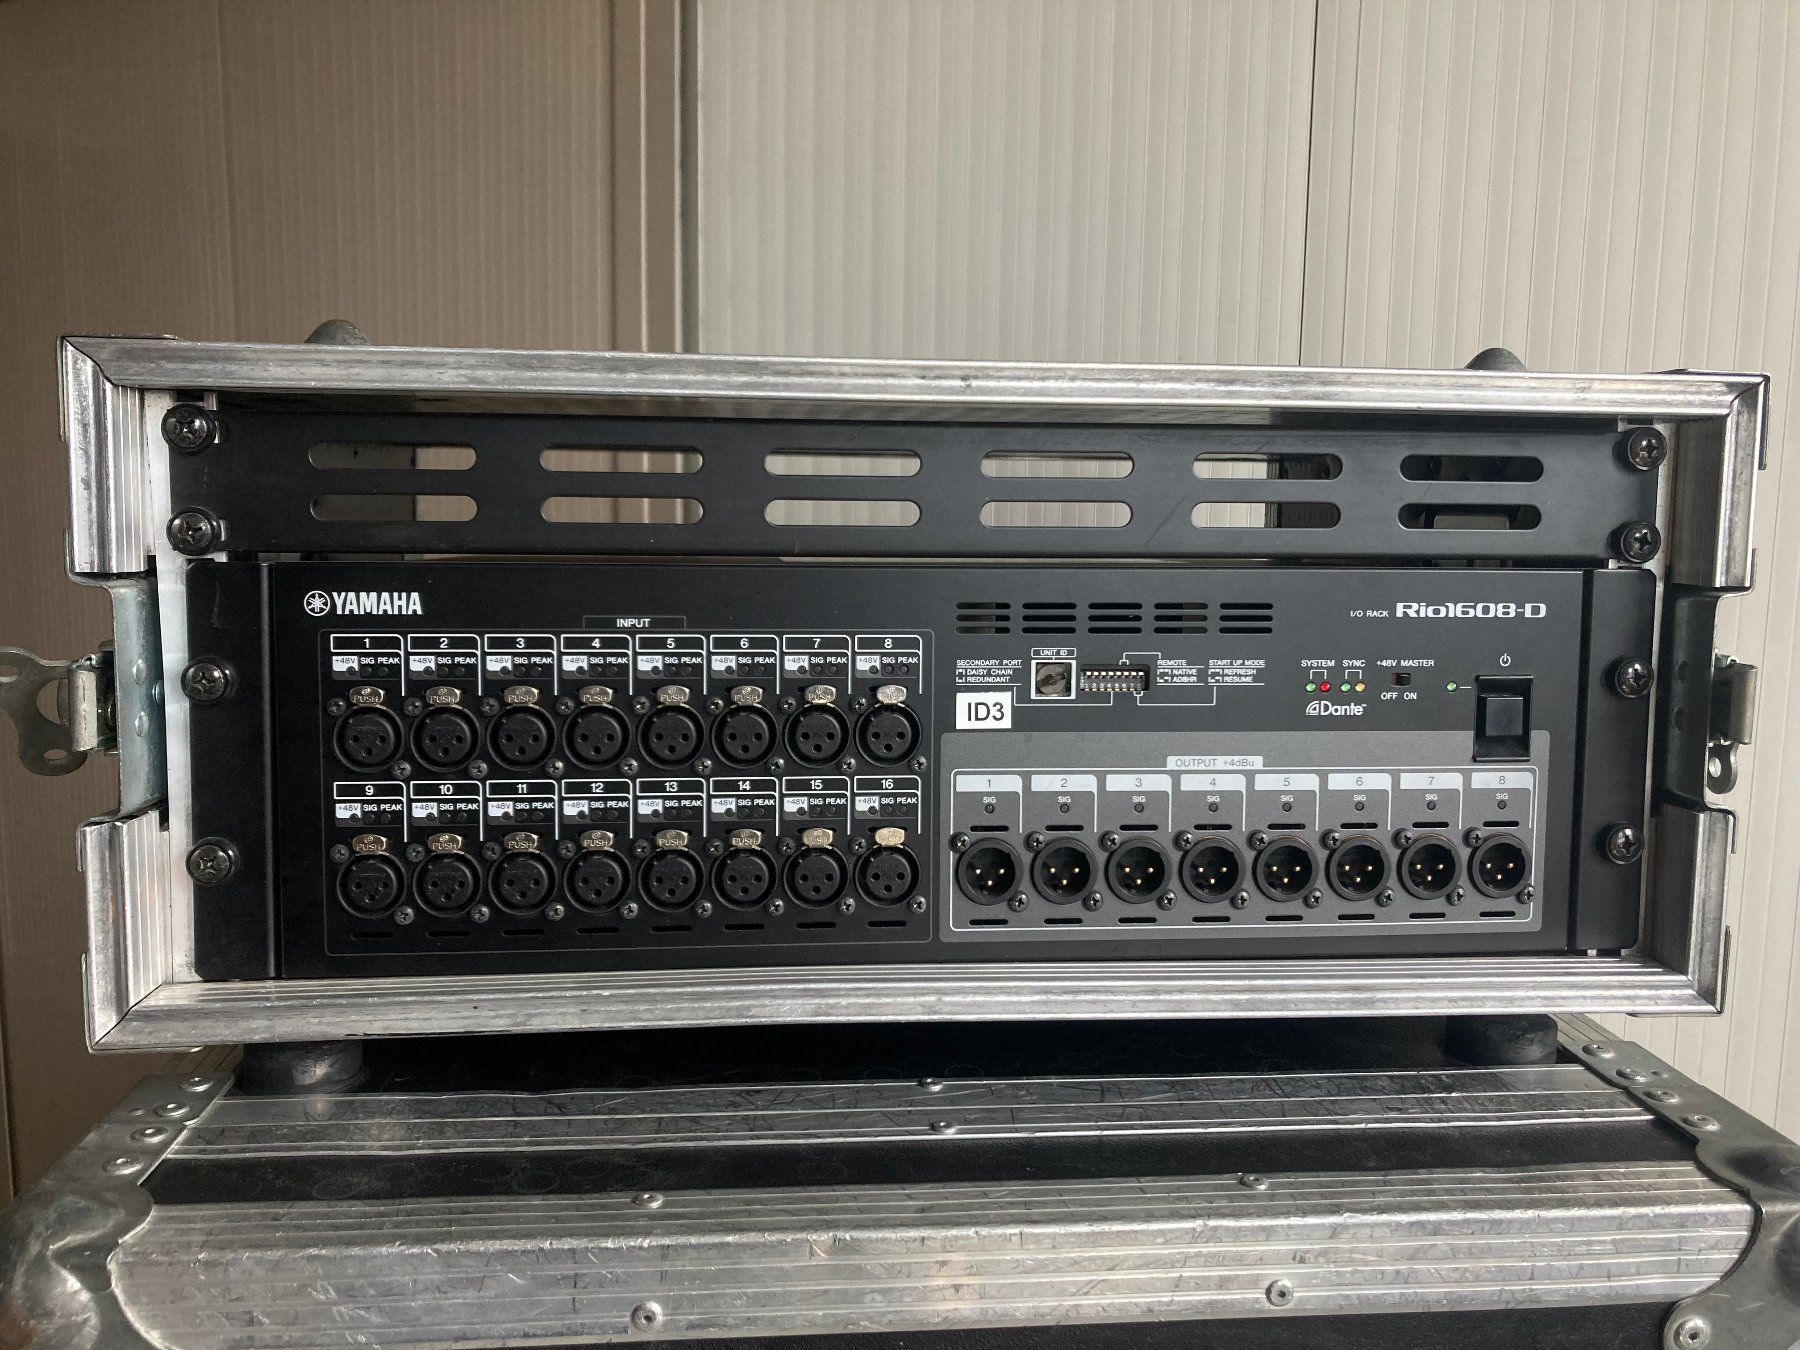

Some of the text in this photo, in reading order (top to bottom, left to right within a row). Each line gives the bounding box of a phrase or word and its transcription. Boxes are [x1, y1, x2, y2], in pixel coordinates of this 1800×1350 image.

[332, 592, 423, 615] YAMAHA
[1395, 602, 1546, 618] Rio1608-D
[617, 618, 651, 628] INPUT
[363, 638, 370, 648] 1
[440, 638, 448, 648] 2
[516, 638, 525, 648] 3
[591, 638, 600, 648] 4
[667, 638, 675, 648] 5
[740, 638, 748, 648] 6
[813, 638, 820, 648] 7
[884, 638, 892, 648] 8
[360, 656, 375, 664] SIG
[377, 656, 400, 664] PEAK
[437, 656, 452, 664] SIG
[454, 656, 477, 664] PEAK
[513, 656, 528, 664] SIG
[530, 656, 553, 664] PEAK
[589, 656, 604, 664] SIG
[606, 656, 629, 664] PEAK
[639, 656, 703, 665] +48V SIG PEAK
[713, 656, 776, 665] +48V SIG PEAK
[786, 656, 847, 665] +48V SIG PEAK
[858, 656, 919, 665] +48V SIG PEAK
[354, 695, 378, 703] PUSH
[1381, 692, 1417, 700] OFF ON
[967, 702, 1005, 722] ID3
[1175, 758, 1255, 768] OUTPUT +4dBu
[809, 780, 822, 790] 15
[881, 779, 893, 789] 16
[986, 778, 992, 788] 1
[1060, 778, 1069, 788] 2
[1135, 777, 1143, 787] 3
[1209, 777, 1217, 787] 4
[1283, 777, 1290, 787] 5
[1356, 776, 1363, 786] 6
[1428, 776, 1435, 786] 7
[1498, 775, 1506, 785] 8
[365, 785, 374, 796] 9
[439, 784, 453, 795] 10
[517, 784, 527, 795] 11
[591, 783, 604, 794] 12
[665, 782, 677, 791] 13
[738, 780, 750, 791] 14
[640, 800, 660, 808] +48V
[858, 797, 877, 805] +48V
[1057, 795, 1070, 803] SIG
[490, 802, 511, 810] +48V
[565, 801, 586, 809] +48V
[357, 843, 381, 851] PUSH
[433, 842, 457, 850] PUSH
